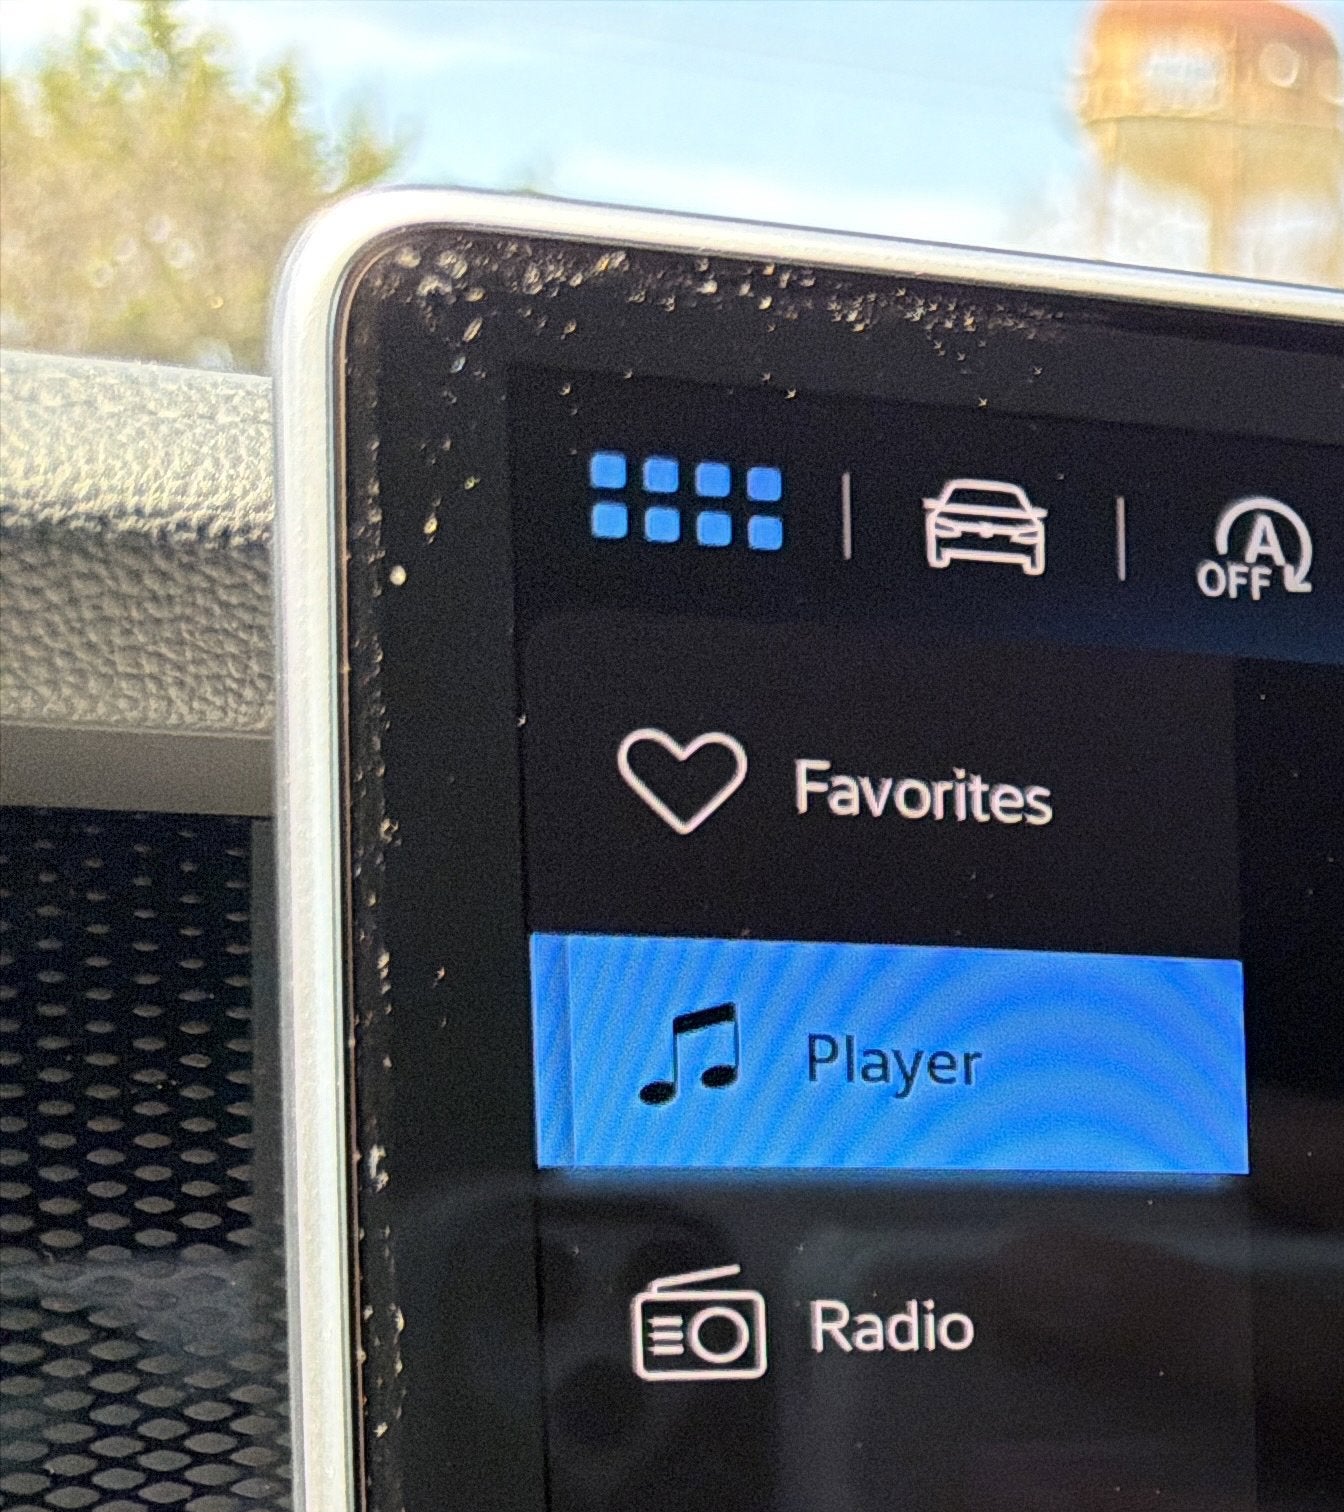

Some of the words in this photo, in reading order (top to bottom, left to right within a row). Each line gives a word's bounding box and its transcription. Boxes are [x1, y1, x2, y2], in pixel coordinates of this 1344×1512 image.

[1197, 560, 1272, 600] OFF
[795, 759, 1054, 826] Favorites
[806, 1033, 983, 1099] Player
[811, 1298, 976, 1354] Radio
